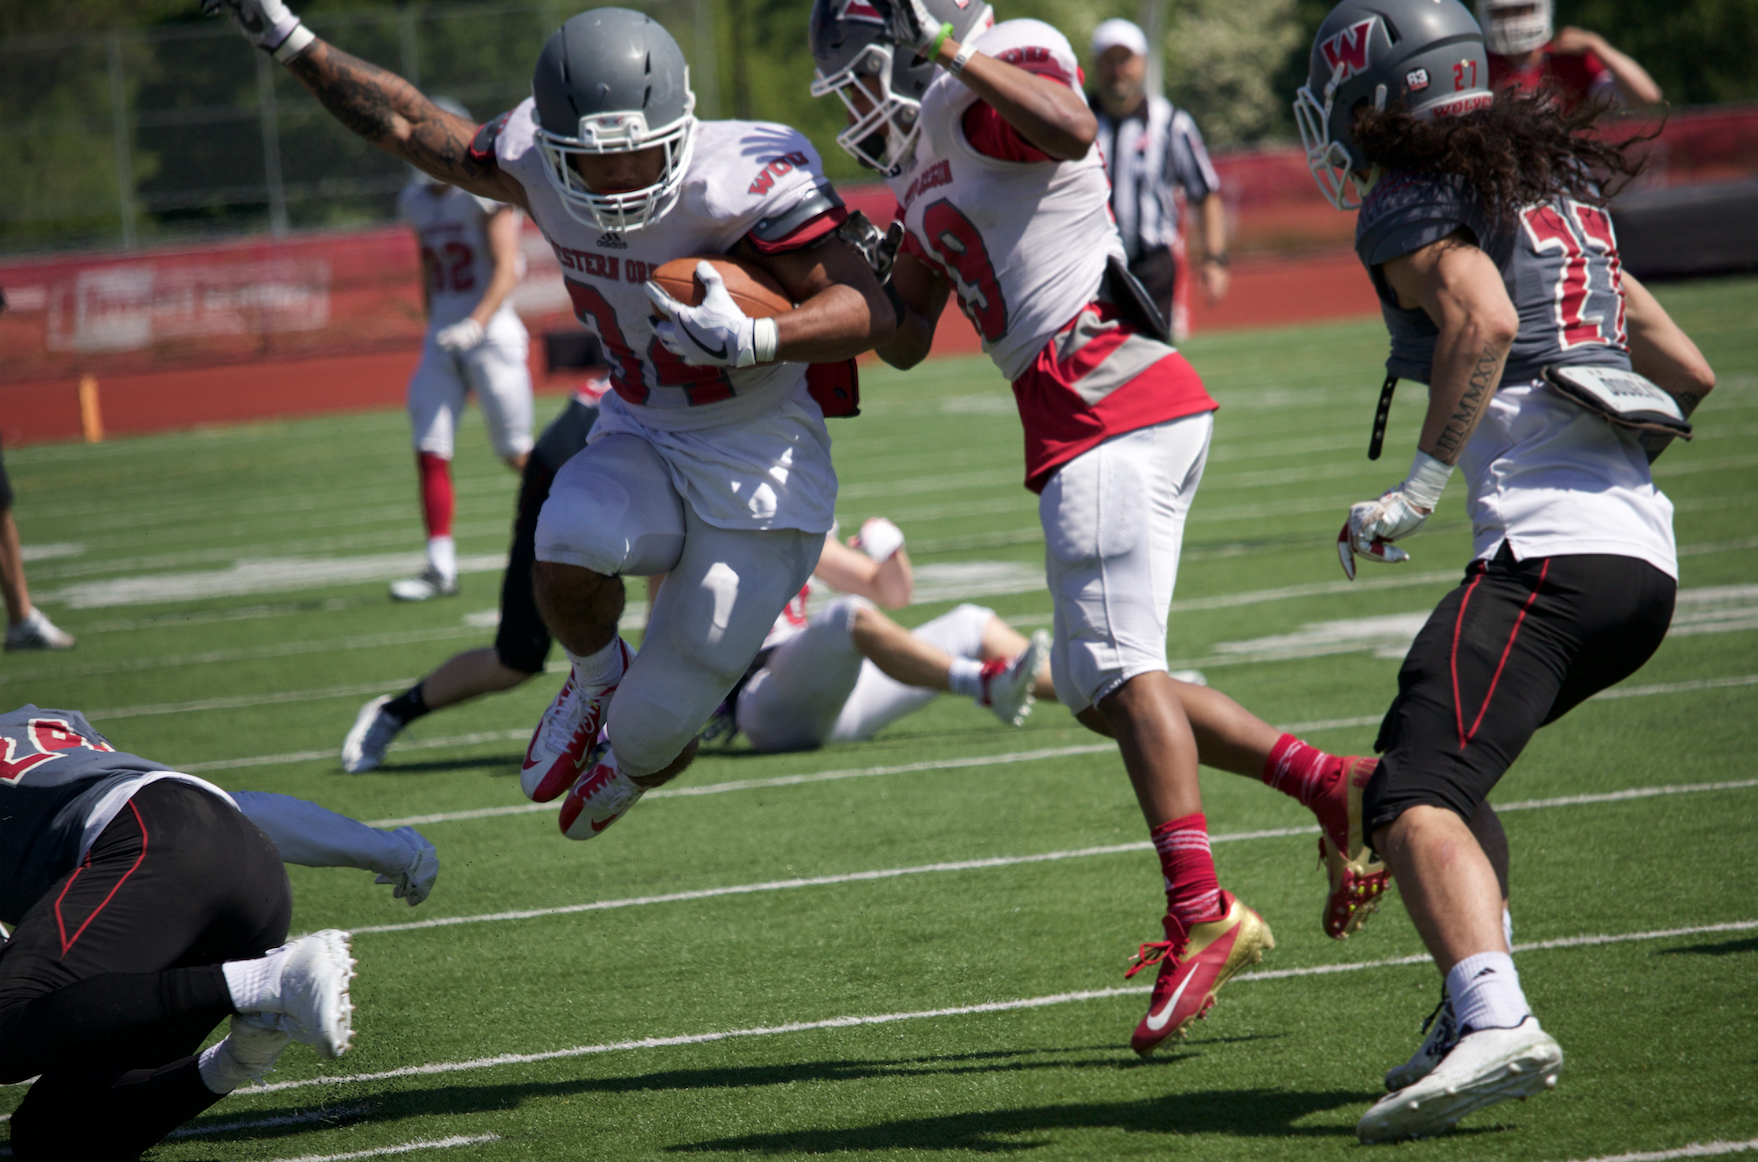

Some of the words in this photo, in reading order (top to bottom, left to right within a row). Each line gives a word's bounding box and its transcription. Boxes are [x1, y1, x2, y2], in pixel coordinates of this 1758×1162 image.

[1320, 15, 1377, 84] W
[1453, 60, 1477, 91] 27
[747, 151, 809, 197] WOU
[549, 236, 620, 281] ESTERN
[596, 239, 628, 250] adidas
[1518, 199, 1632, 352] 27
